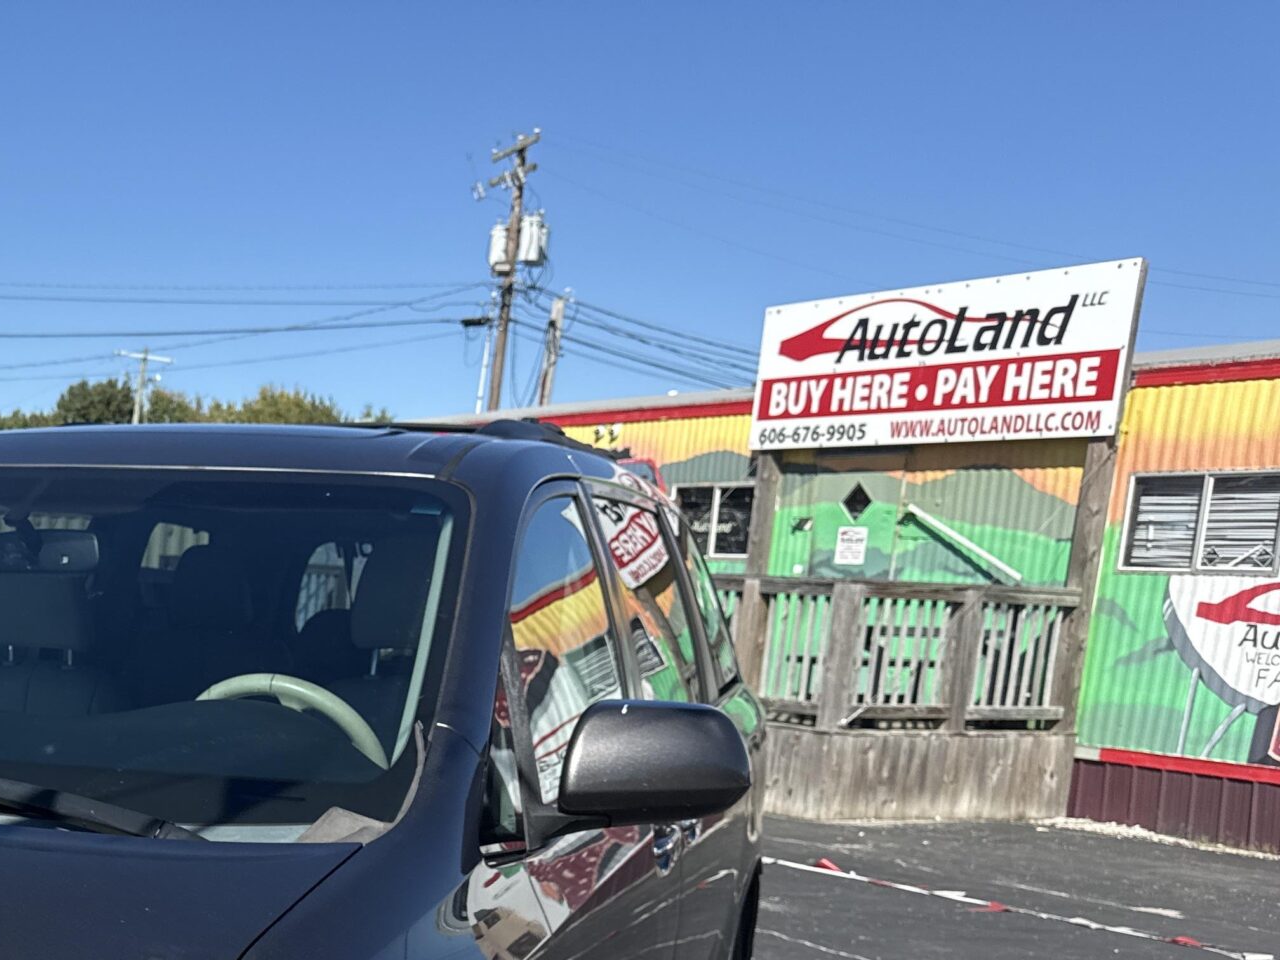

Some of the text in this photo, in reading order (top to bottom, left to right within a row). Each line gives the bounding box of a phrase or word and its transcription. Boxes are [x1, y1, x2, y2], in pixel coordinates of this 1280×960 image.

[835, 291, 1109, 363] AutoLand LLC
[768, 357, 1102, 417] BUY HERE PAY HERE
[758, 411, 1101, 445] 606-676-9905 WWW.AUTOLANDLLC.COM
